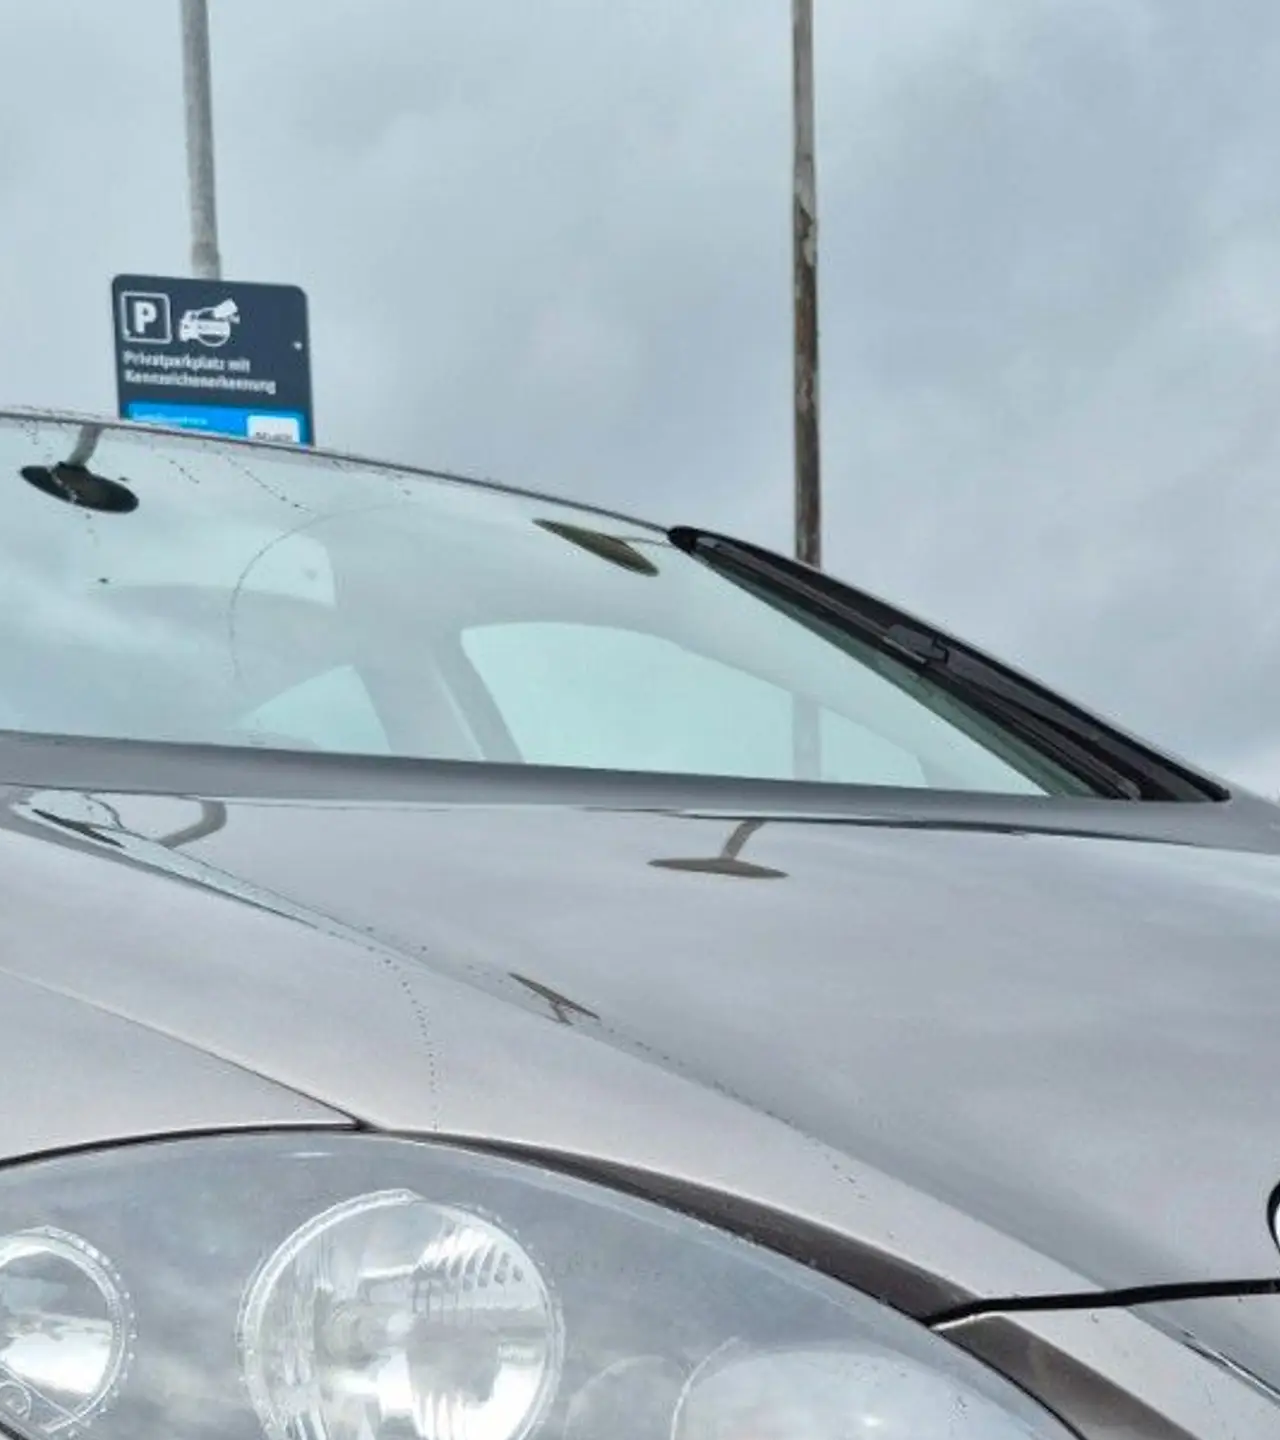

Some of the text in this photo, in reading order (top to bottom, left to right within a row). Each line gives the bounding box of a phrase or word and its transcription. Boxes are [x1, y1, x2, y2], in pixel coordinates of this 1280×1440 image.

[133, 300, 158, 334] P
[123, 350, 251, 374] Privatparkplatz mit
